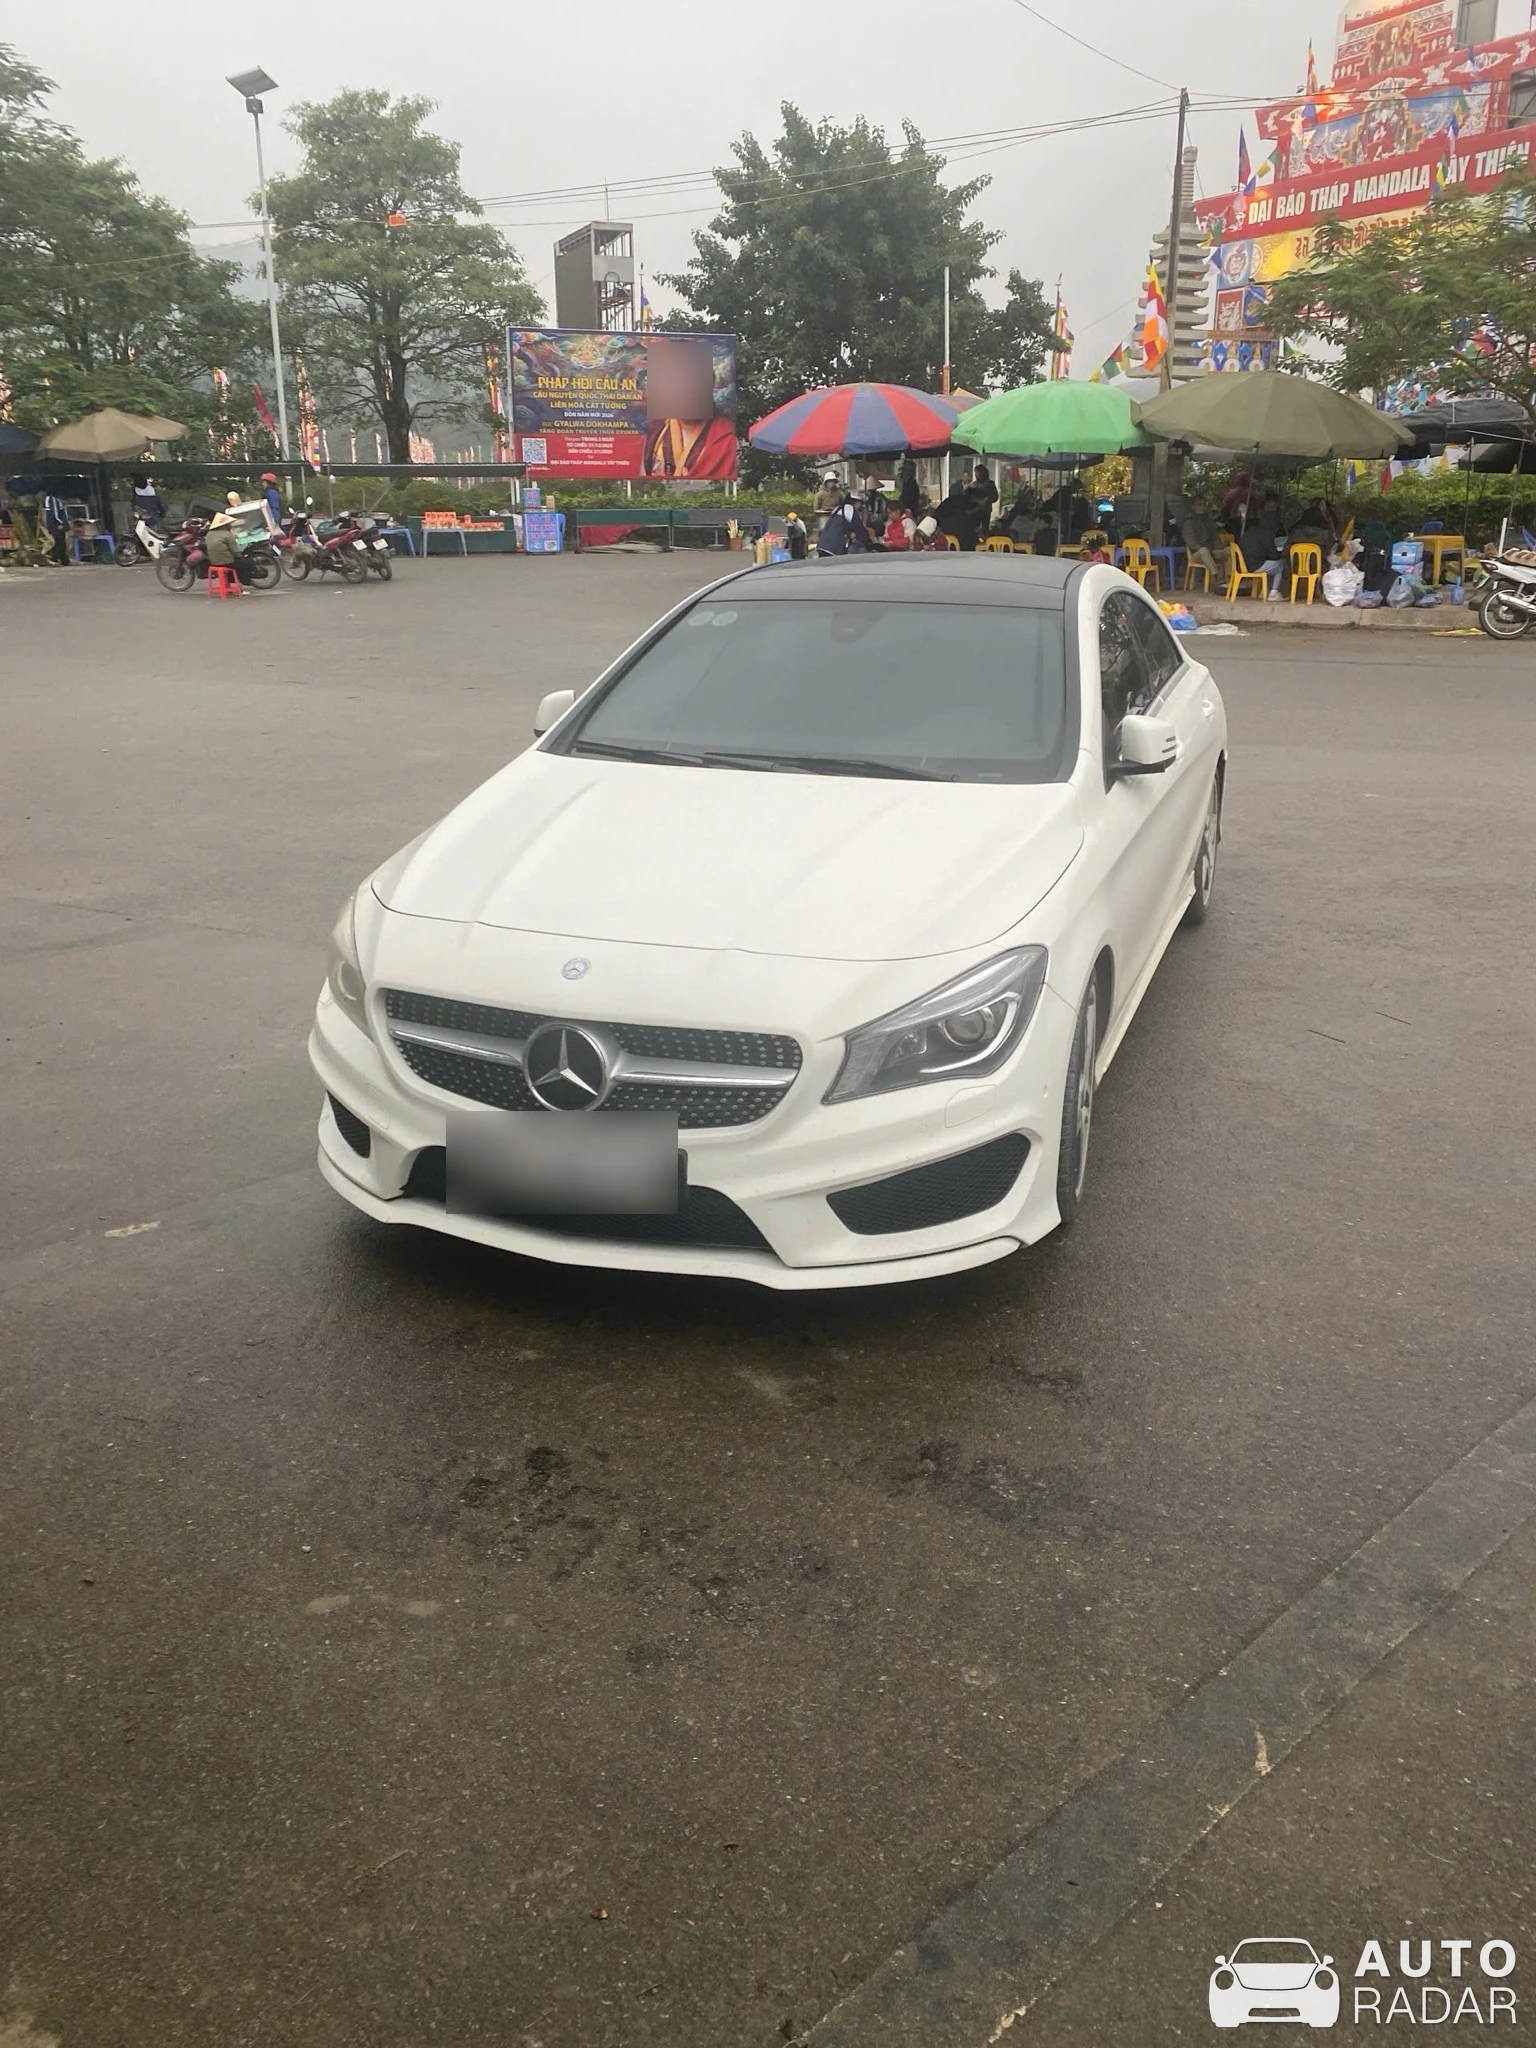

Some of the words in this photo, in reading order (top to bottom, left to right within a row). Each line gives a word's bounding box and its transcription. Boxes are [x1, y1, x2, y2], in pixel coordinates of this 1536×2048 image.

[1275, 188, 1306, 219] BẢO
[1310, 181, 1350, 212] THÁP
[1352, 164, 1430, 204] MANDALA
[620, 378, 637, 390] AN
